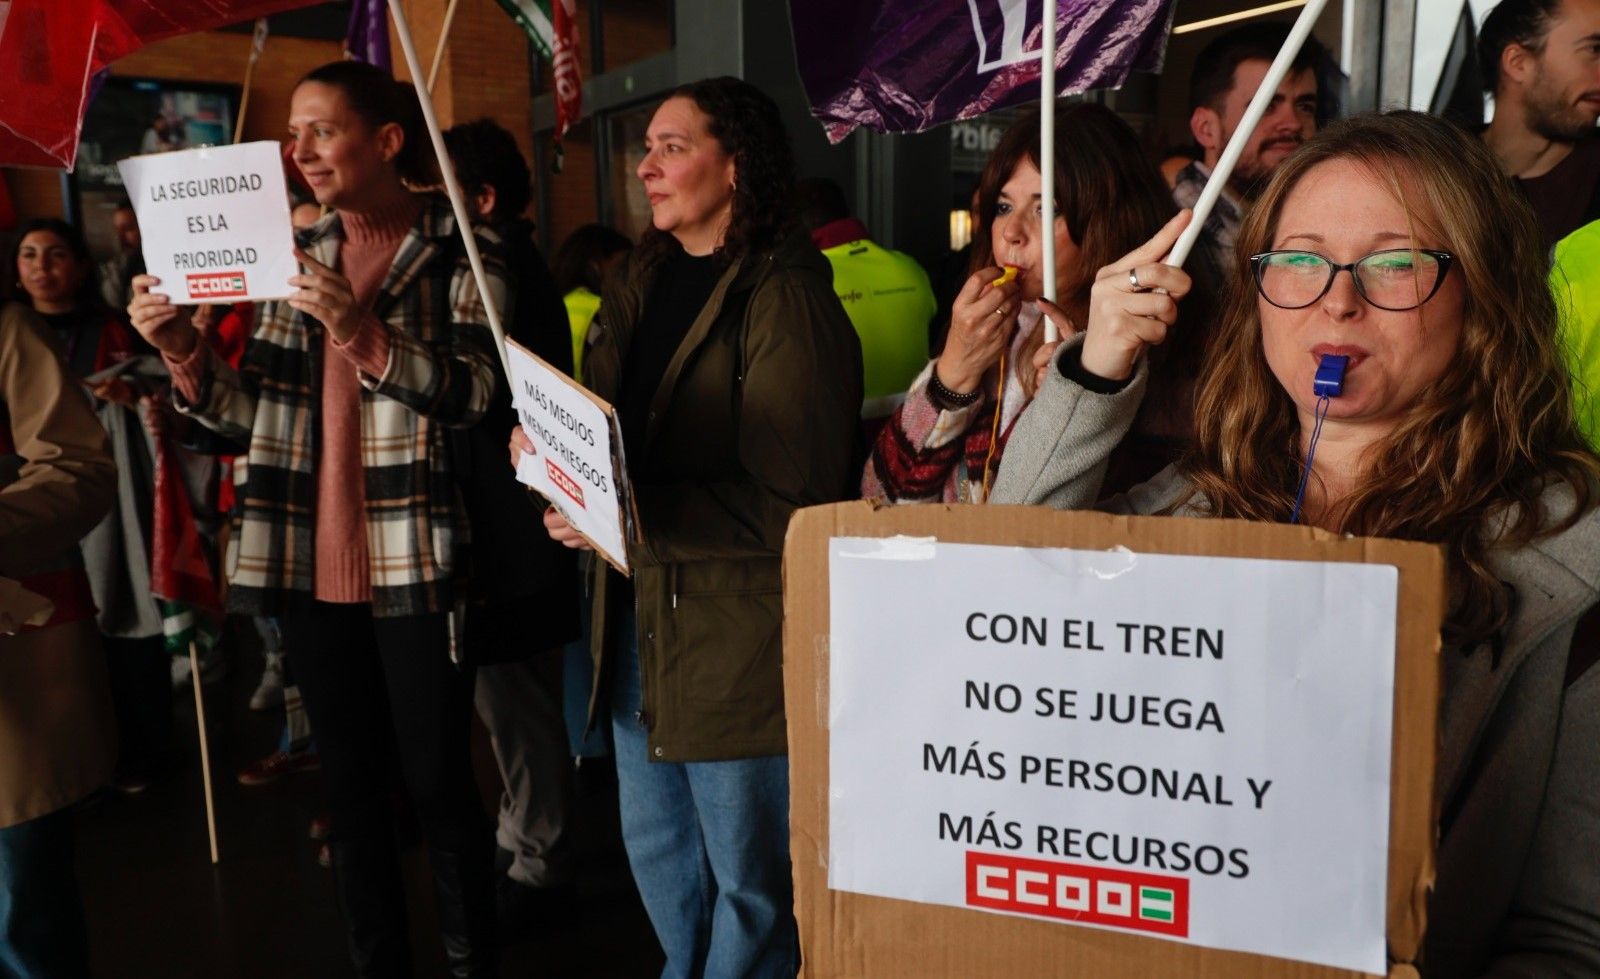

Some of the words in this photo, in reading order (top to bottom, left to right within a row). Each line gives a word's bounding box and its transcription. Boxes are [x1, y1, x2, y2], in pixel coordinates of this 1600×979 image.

[150, 184, 168, 202] LA
[169, 173, 263, 200] SEGURIDAD
[186, 215, 205, 234] ES
[208, 213, 229, 232] LA
[173, 247, 258, 270] PRIORIDAD
[524, 379, 547, 411] MÁS
[548, 399, 595, 447] MEDIOS
[522, 408, 558, 452] MENOS
[559, 442, 608, 493] RIESGOS
[965, 612, 1047, 647] CON
[1063, 618, 1104, 651] EL
[1116, 622, 1224, 660] TREN
[964, 680, 1022, 713] NO
[1034, 687, 1078, 719] SE
[1090, 692, 1225, 733] JUEGA
[923, 741, 1007, 781] MÁS
[1020, 755, 1233, 807] PERSONAL
[1247, 777, 1273, 809] Y
[938, 811, 1023, 850] MÁS
[1036, 825, 1250, 879] RECURSOS
